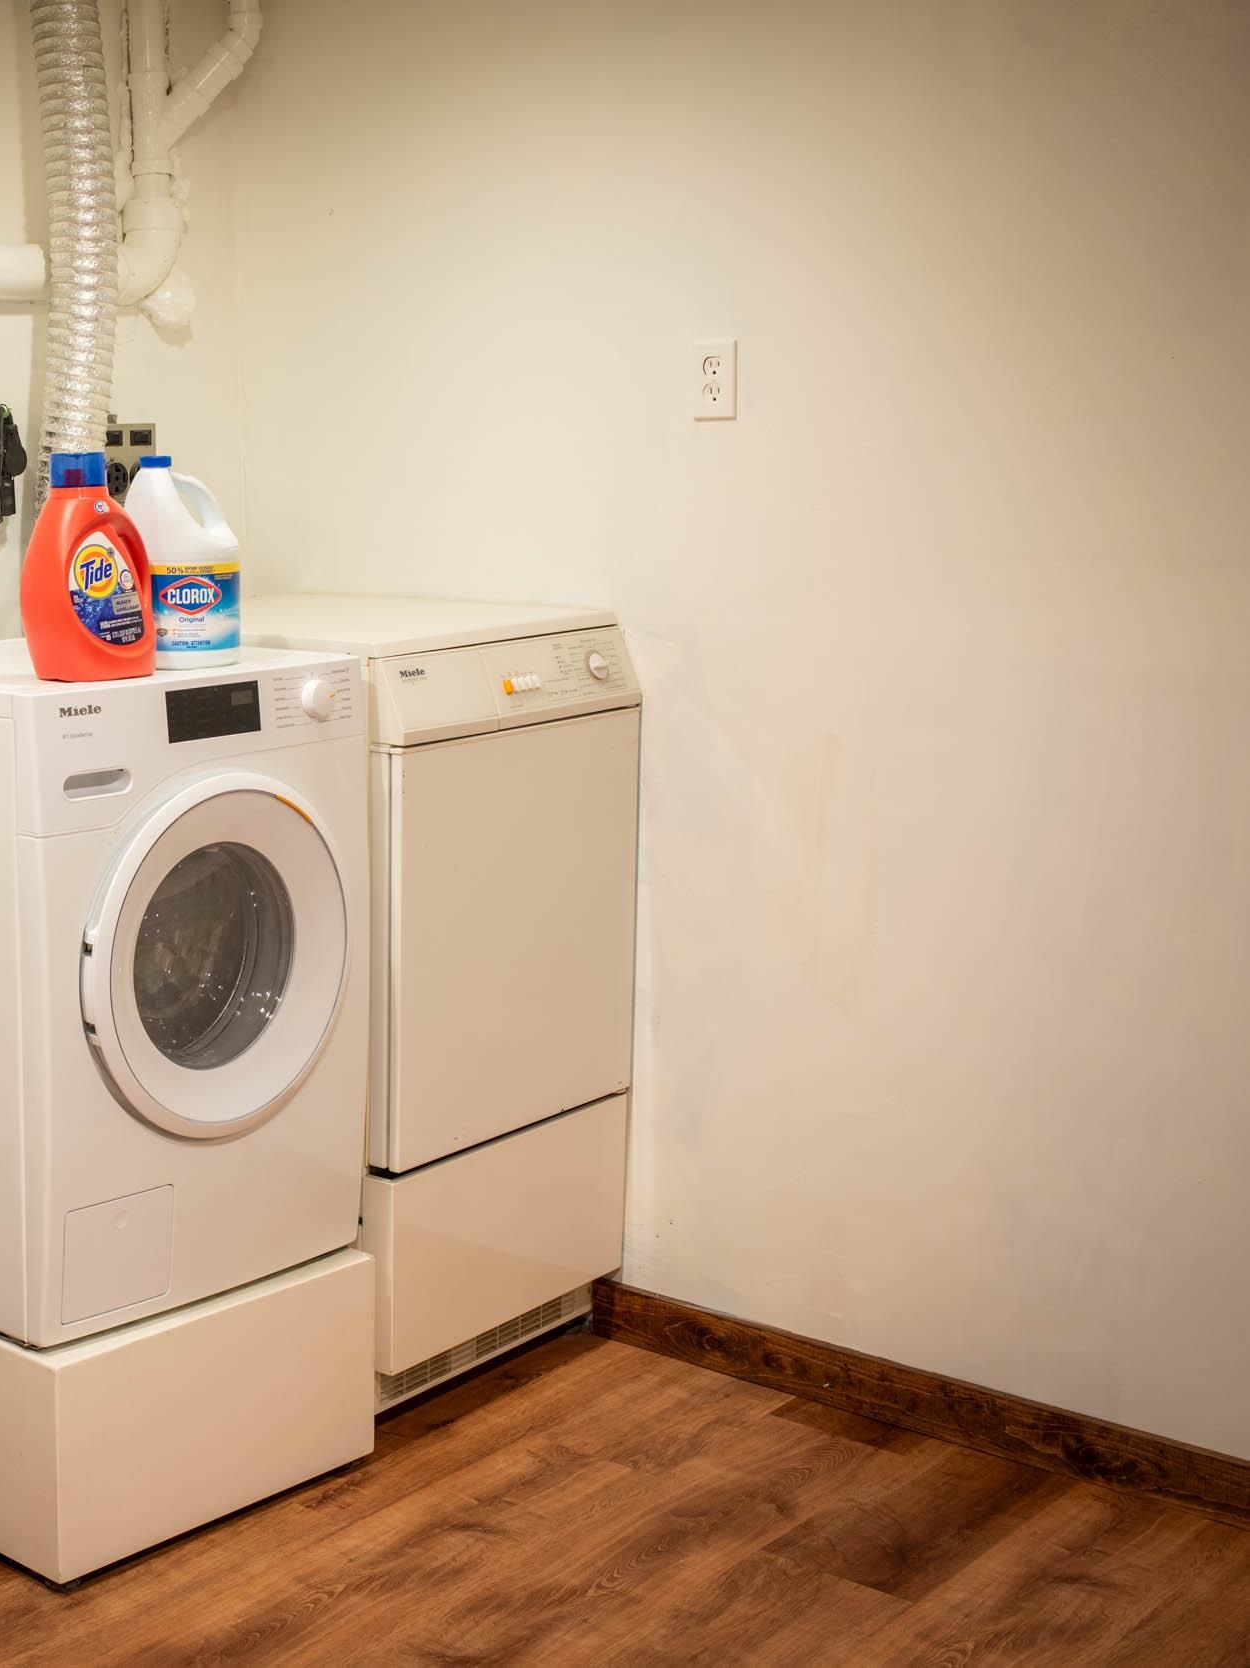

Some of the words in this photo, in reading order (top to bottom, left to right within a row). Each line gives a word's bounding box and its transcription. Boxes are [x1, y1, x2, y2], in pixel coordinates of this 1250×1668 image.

[79, 558, 112, 591] Tide
[167, 588, 215, 604] CLOROX
[399, 668, 426, 678] Miele
[59, 704, 102, 718] Miele
